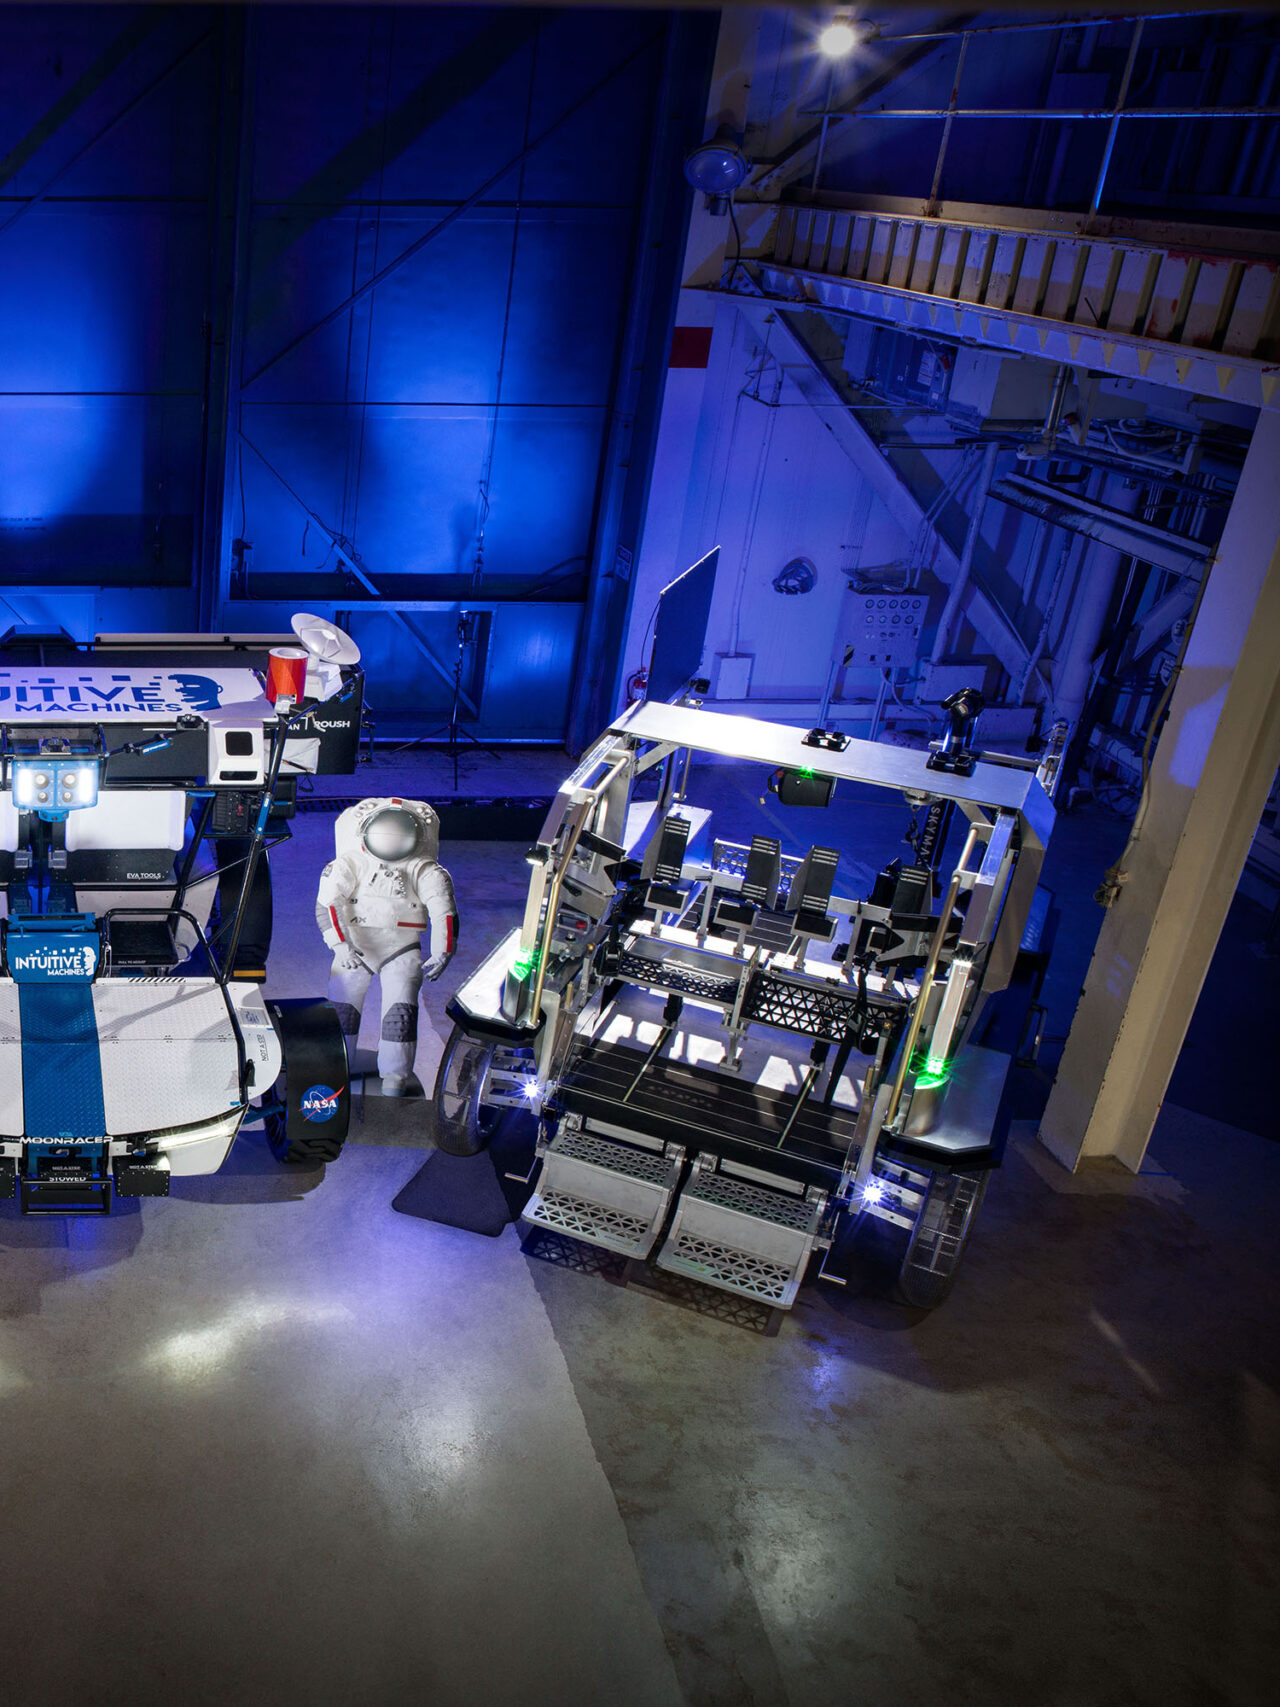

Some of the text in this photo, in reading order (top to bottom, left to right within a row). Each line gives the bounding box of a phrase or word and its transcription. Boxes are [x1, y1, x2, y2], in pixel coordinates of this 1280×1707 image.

[15, 701, 183, 712] MACHINES
[314, 720, 351, 728] ROUSH
[15, 956, 82, 970] INTUITIVE
[47, 968, 85, 976] MACHINES
[303, 1099, 337, 1109] NASA
[19, 1136, 114, 1145] MOONRACER
